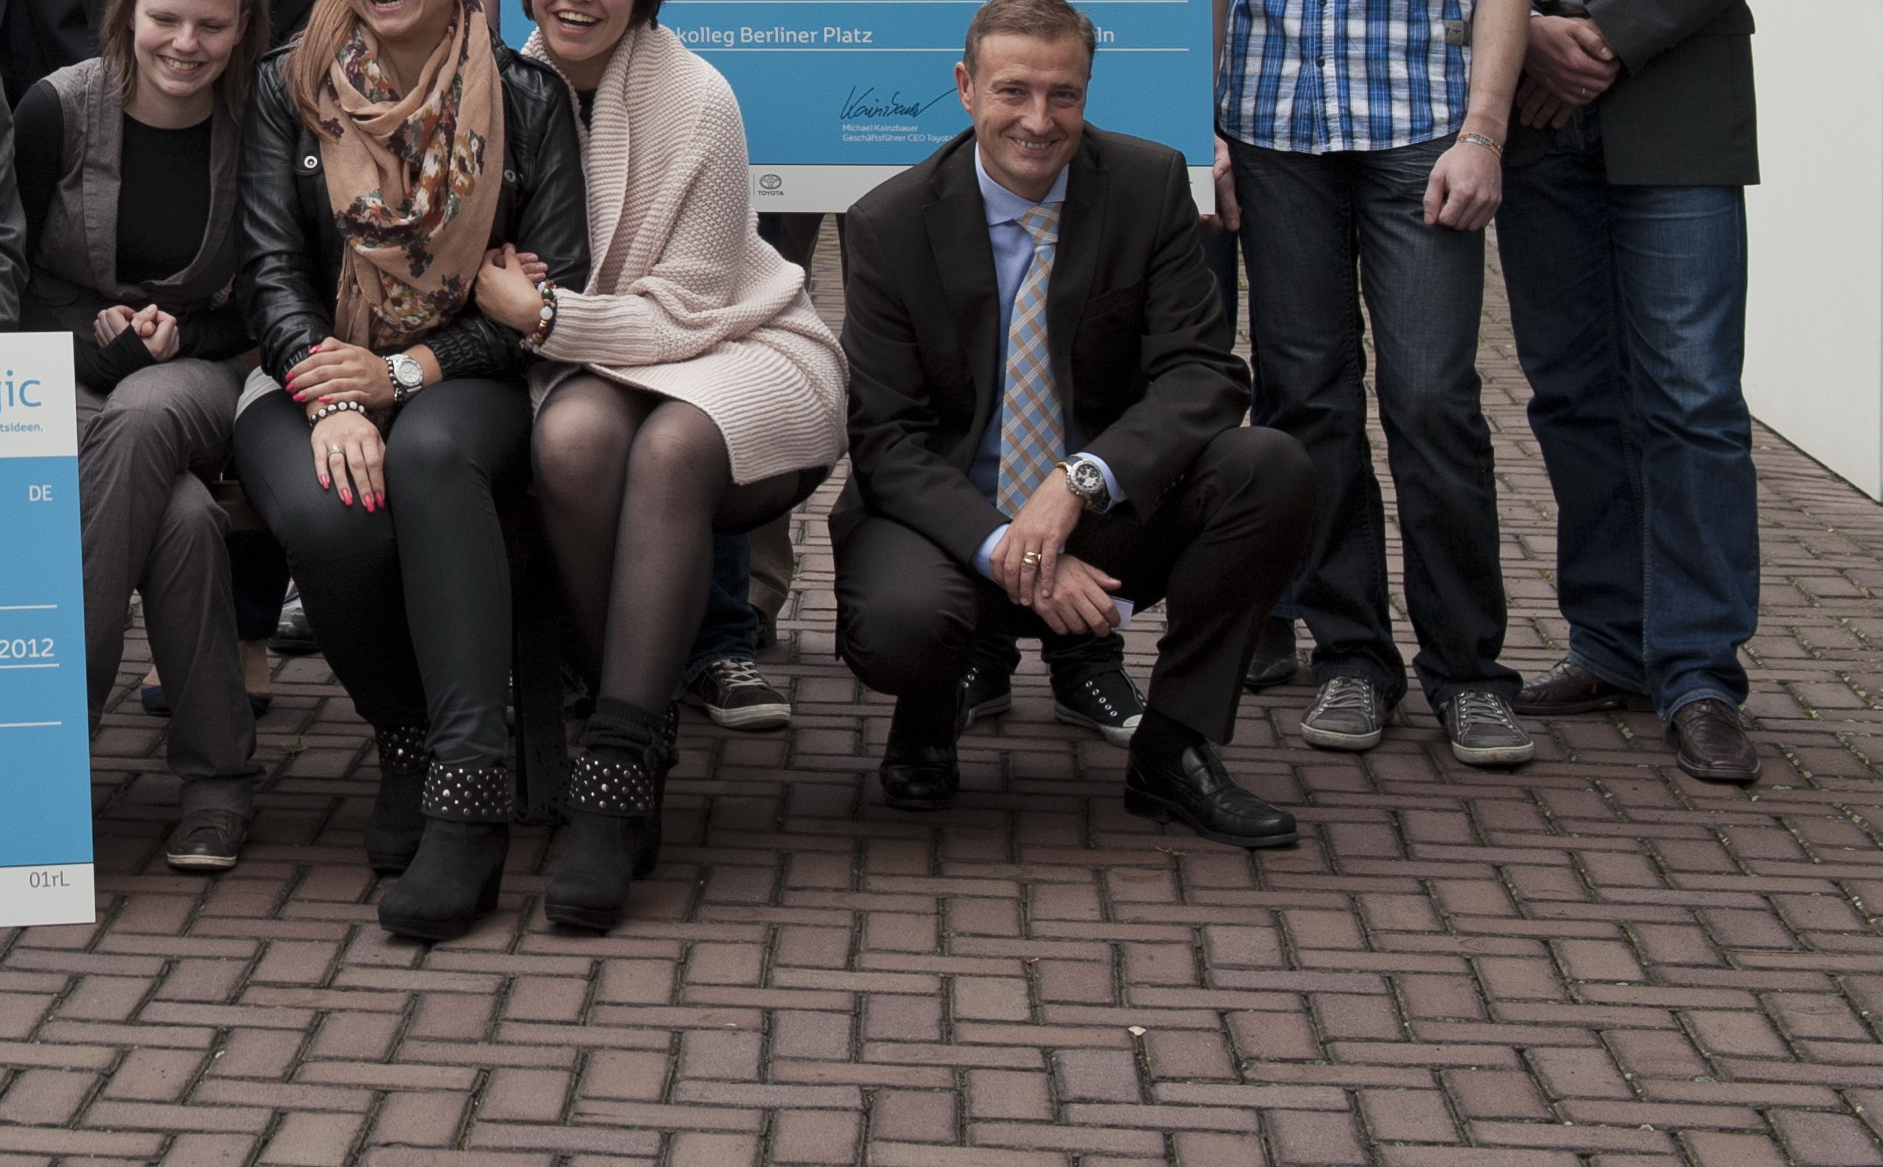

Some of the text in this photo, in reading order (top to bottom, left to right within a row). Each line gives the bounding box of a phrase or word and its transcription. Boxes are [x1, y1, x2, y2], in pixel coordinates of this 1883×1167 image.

[677, 26, 873, 47] kolleg Berliner Platz
[841, 123, 917, 131] Michael Kainzbauer
[906, 133, 925, 141] CEO
[28, 484, 53, 501] DE
[28, 869, 70, 888] 01rL
